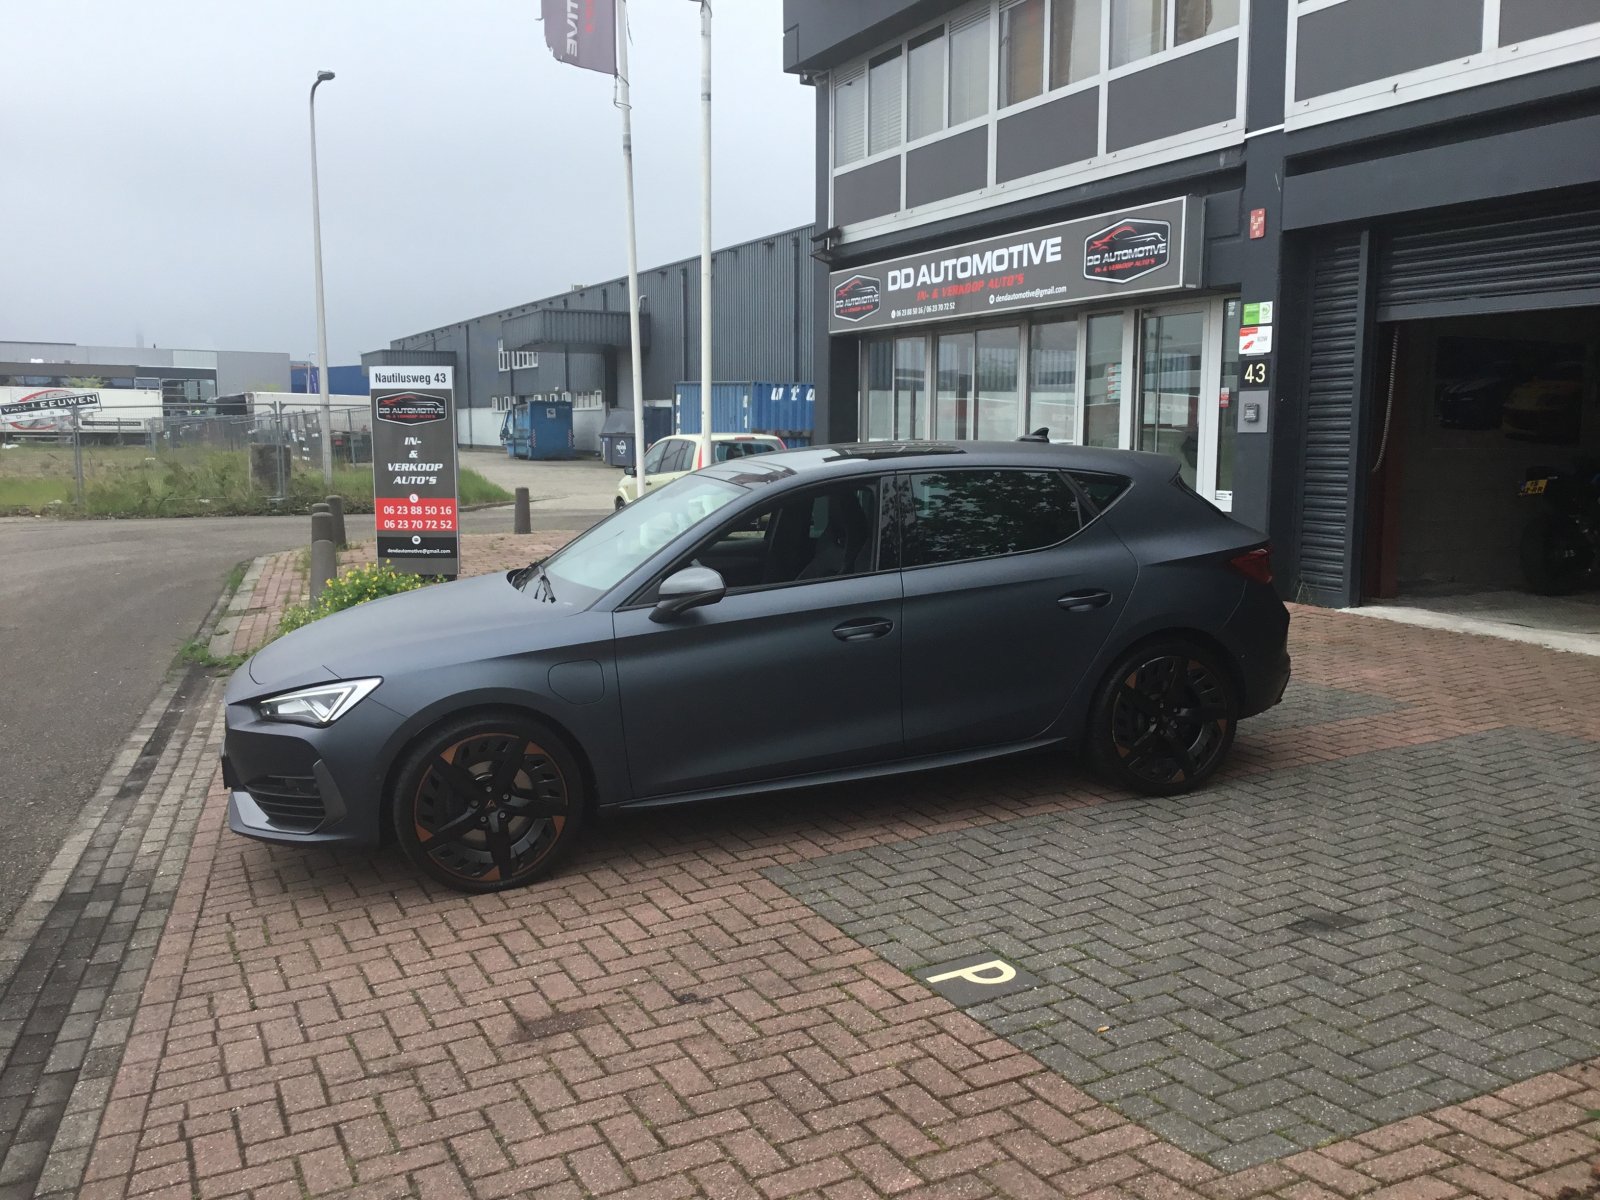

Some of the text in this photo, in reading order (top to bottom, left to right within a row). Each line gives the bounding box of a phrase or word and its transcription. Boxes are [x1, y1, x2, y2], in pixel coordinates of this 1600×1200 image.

[1087, 243, 1166, 266] DD AUTOMOTIVE
[888, 236, 1062, 291] DD AUTOMOTIVE
[942, 280, 985, 298] VERKOOP
[988, 273, 1024, 289] AUTO'S
[375, 372, 447, 385] Nautilusweg 43
[1244, 363, 1266, 384] 43
[404, 437, 422, 446] IN-
[409, 450, 418, 458] &
[388, 463, 443, 472] VERKOOP
[393, 476, 437, 484] AUTO'S
[383, 506, 452, 515] 06 23 88 50 16
[384, 520, 452, 529] 06 23 70 72 52
[926, 959, 1017, 985] P
